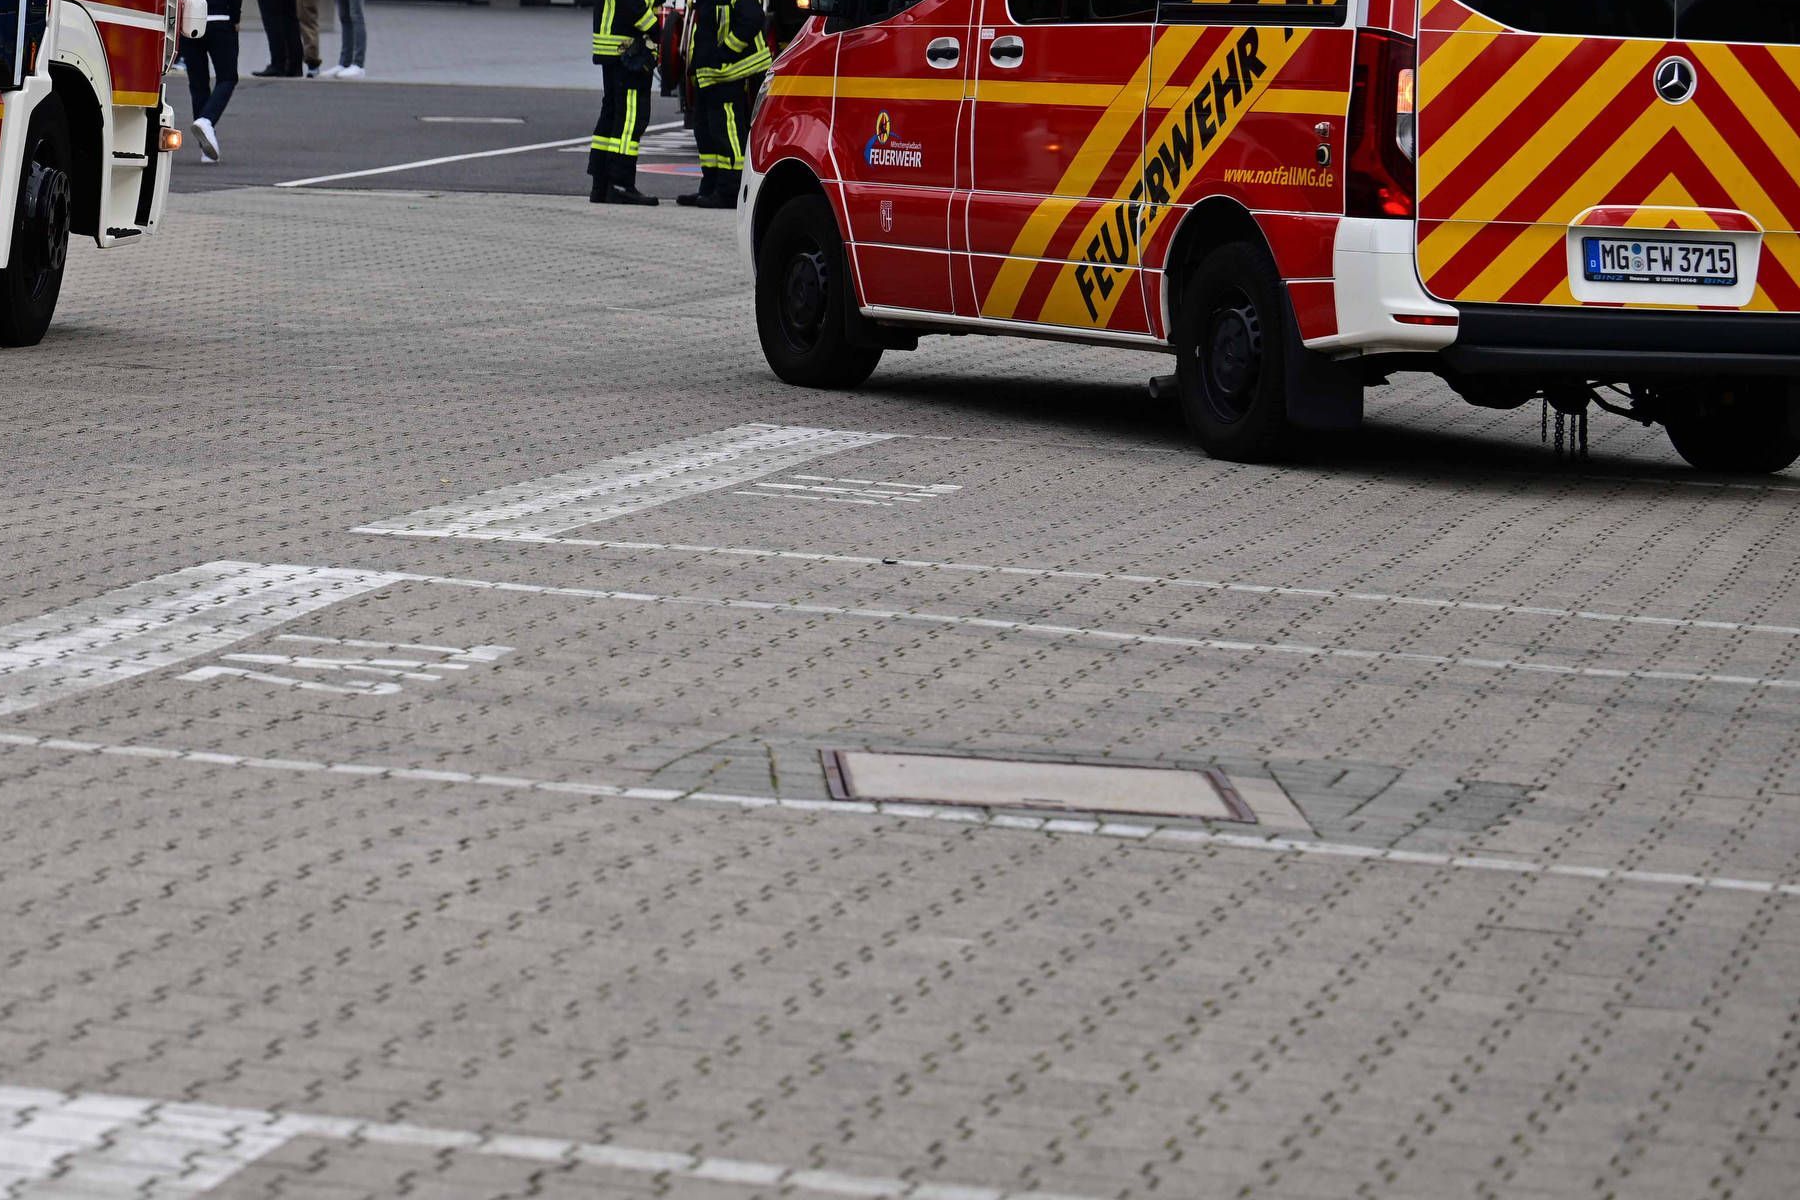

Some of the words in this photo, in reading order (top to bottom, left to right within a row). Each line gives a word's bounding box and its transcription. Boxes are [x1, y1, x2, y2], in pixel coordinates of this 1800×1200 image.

[869, 148, 922, 168] FEUERWEHR
[1074, 25, 1268, 323] FEUERWEHR
[1223, 165, 1334, 188] www.notfallMG.de
[1601, 243, 1630, 270] MG
[1645, 246, 1673, 272] FW
[1678, 246, 1731, 274] 3715
